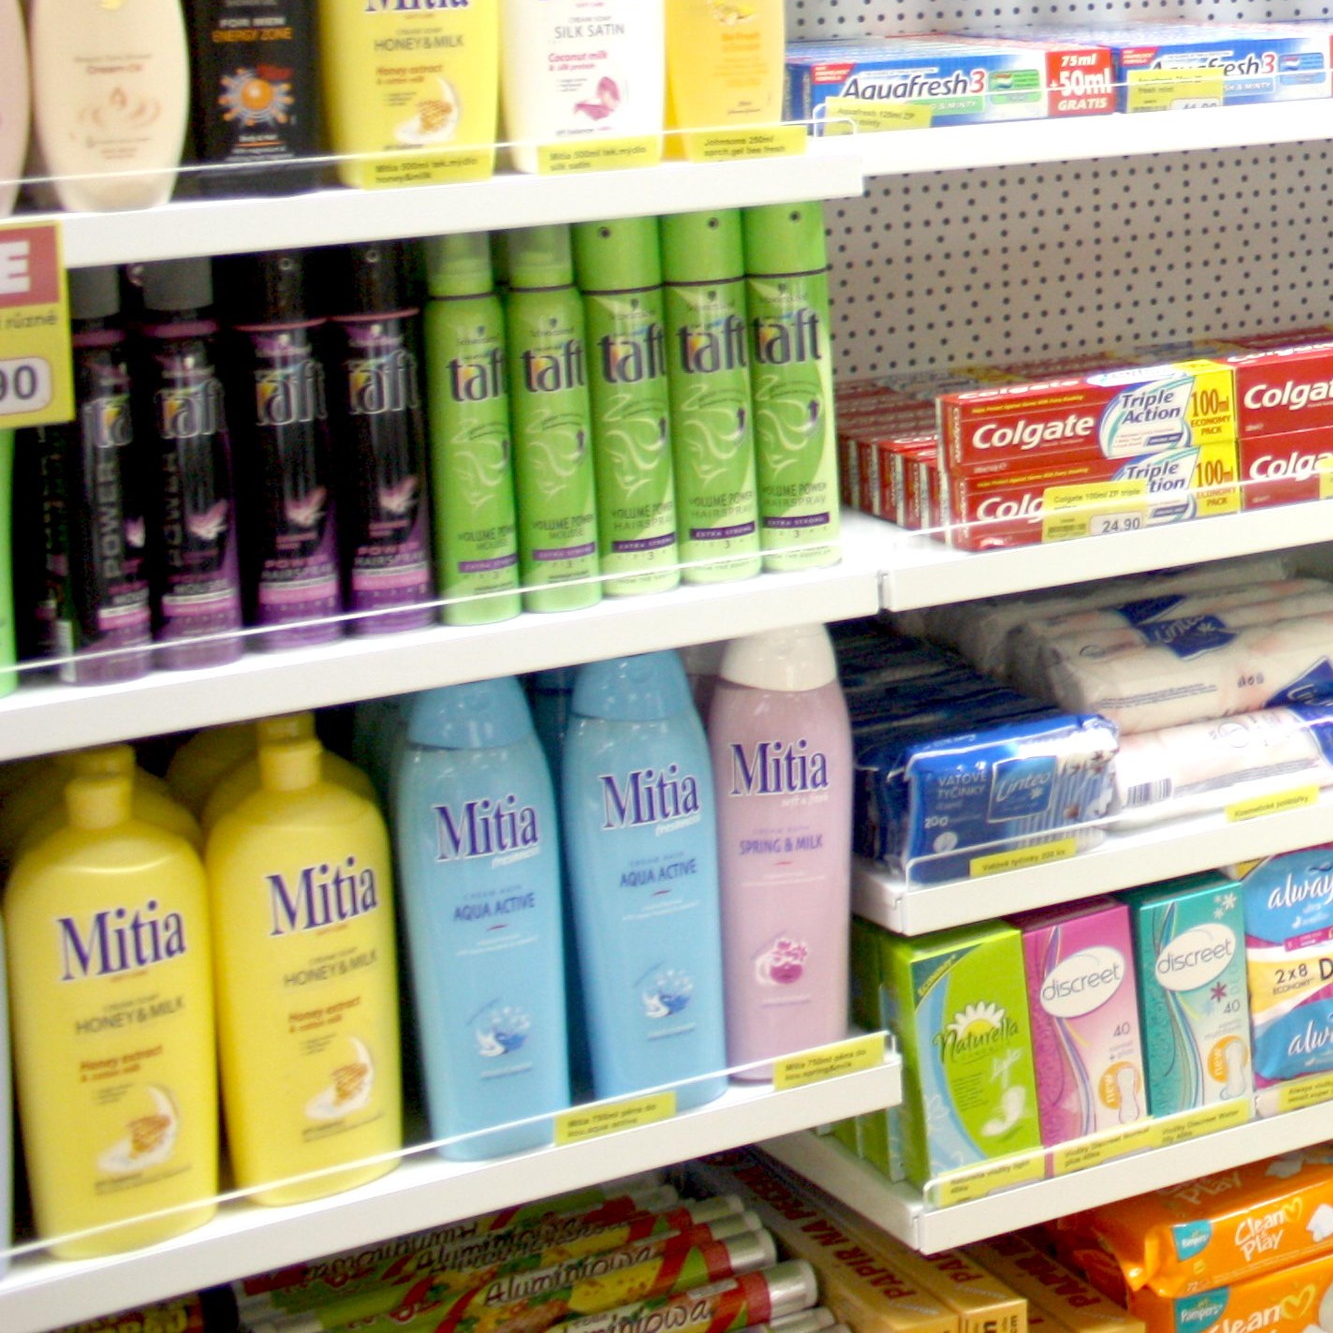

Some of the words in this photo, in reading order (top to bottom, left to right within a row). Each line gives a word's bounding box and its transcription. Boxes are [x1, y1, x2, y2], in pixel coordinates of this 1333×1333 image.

[554, 25, 583, 39] SILK
[587, 22, 626, 37] SATIN
[1060, 52, 1098, 68] 75ml
[1057, 96, 1108, 112] GRATIS
[677, 314, 746, 375] taft
[752, 308, 822, 365] taft
[1120, 389, 1175, 413] Triple
[1122, 404, 1182, 426] Action
[1189, 388, 1232, 418] 100ml
[971, 414, 1096, 451] Colgate
[1101, 514, 1142, 534] 24.90
[730, 737, 831, 798] Mitia
[599, 763, 701, 831] Mitia
[433, 793, 540, 863] Mitia
[738, 837, 782, 856] SPRING
[794, 832, 825, 852] MILK
[618, 868, 657, 889] AQUA
[656, 857, 698, 880] ACTIVE
[265, 854, 380, 937] Mitia
[57, 897, 188, 982] Mitia
[1155, 936, 1232, 975] discreet
[1041, 963, 1123, 1002] discreet
[931, 1016, 1019, 1063] Naturella
[1234, 1205, 1287, 1247] Clean
[1240, 1228, 1285, 1264] Play
